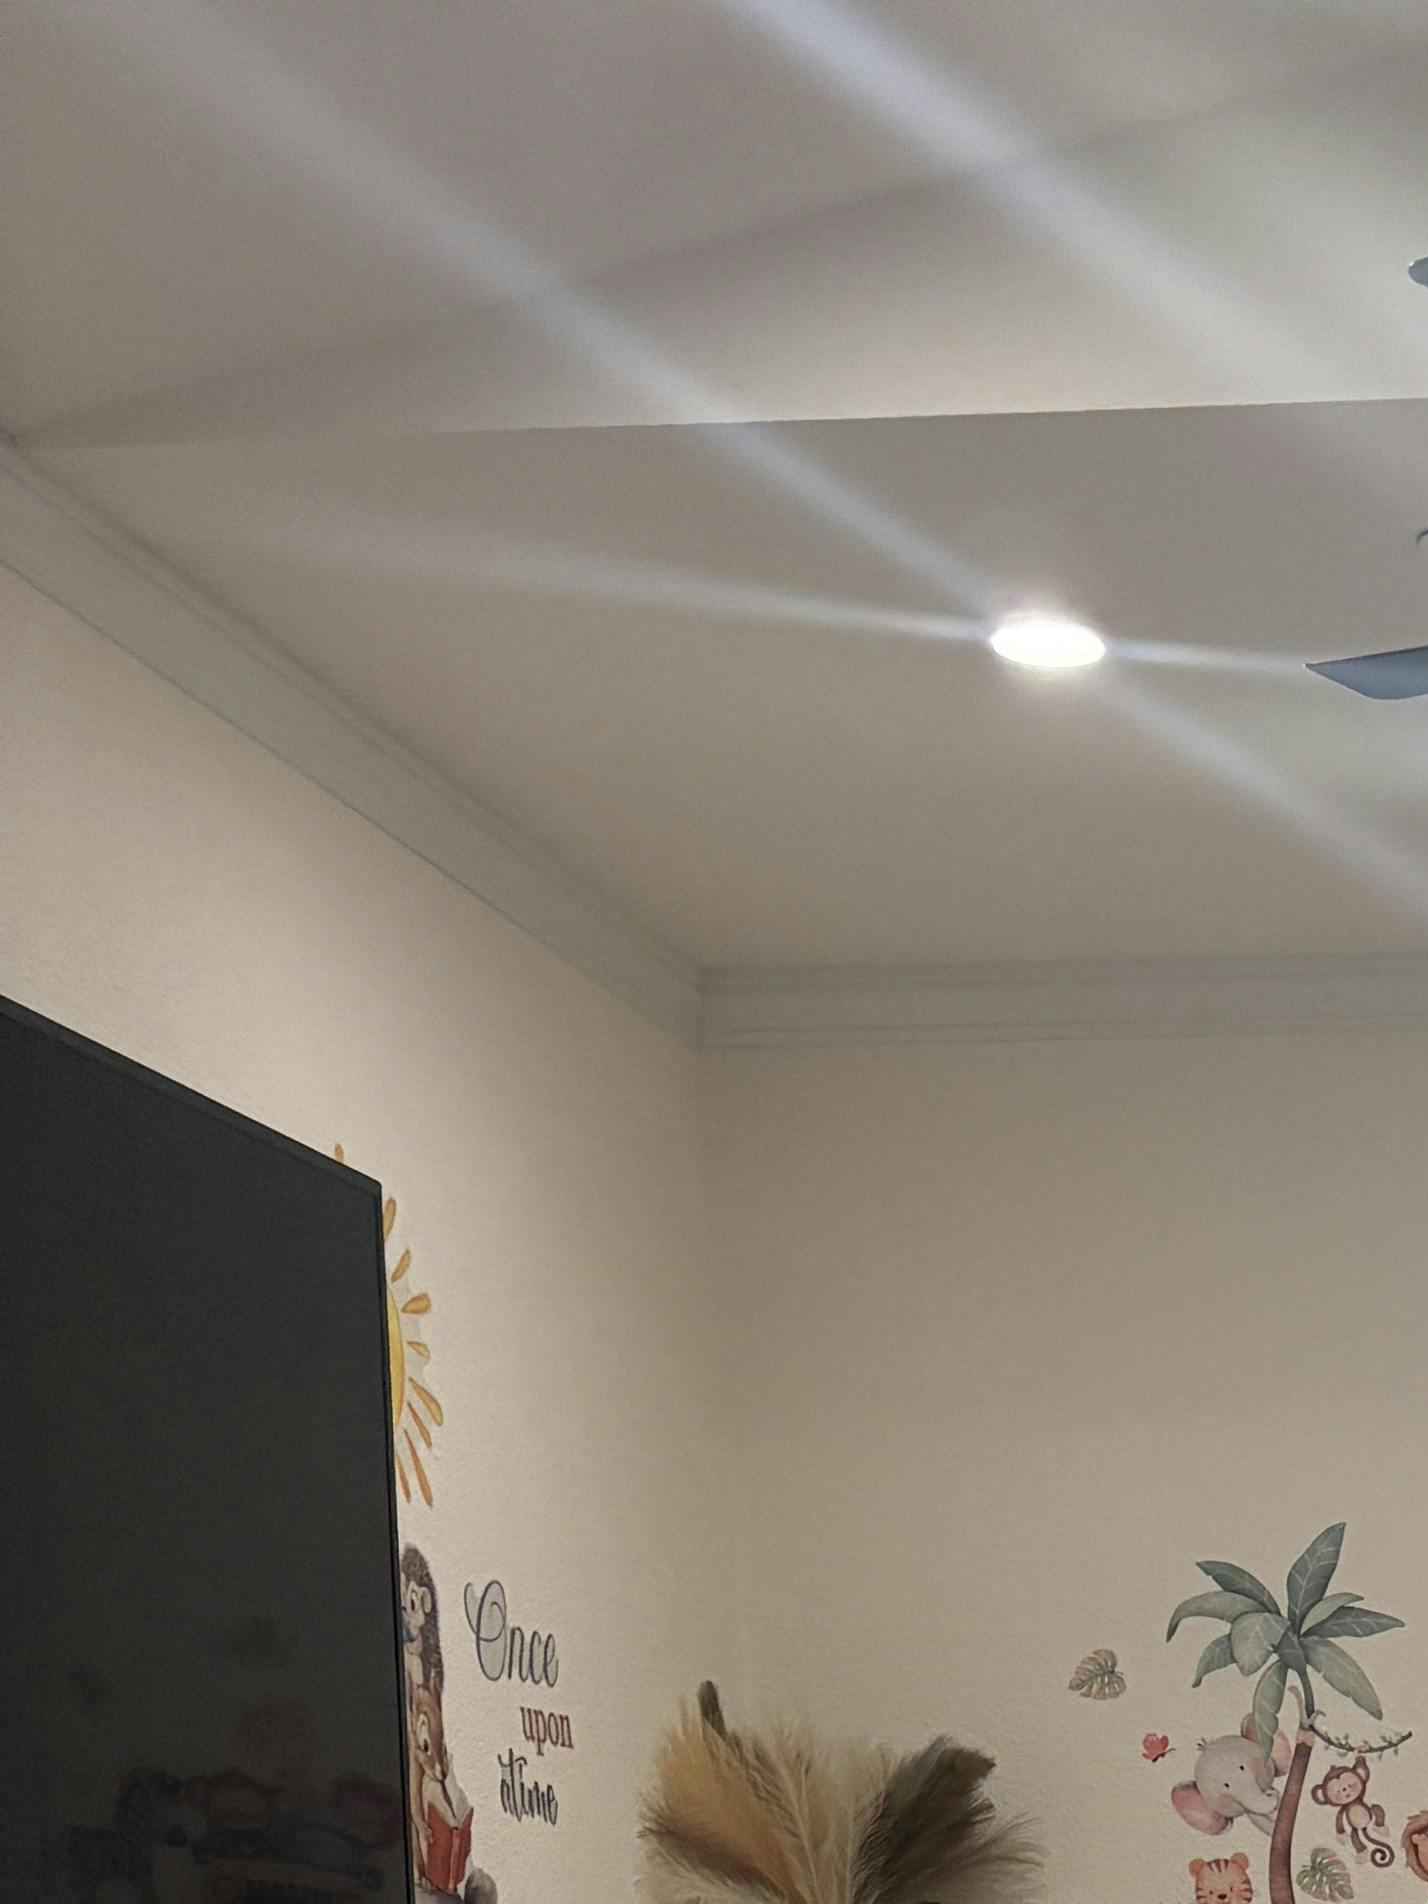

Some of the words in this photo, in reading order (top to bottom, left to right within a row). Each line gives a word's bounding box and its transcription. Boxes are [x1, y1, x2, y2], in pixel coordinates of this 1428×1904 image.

[464, 1580, 560, 1688] Once
[519, 1705, 574, 1757] upon
[498, 1747, 559, 1826] time
